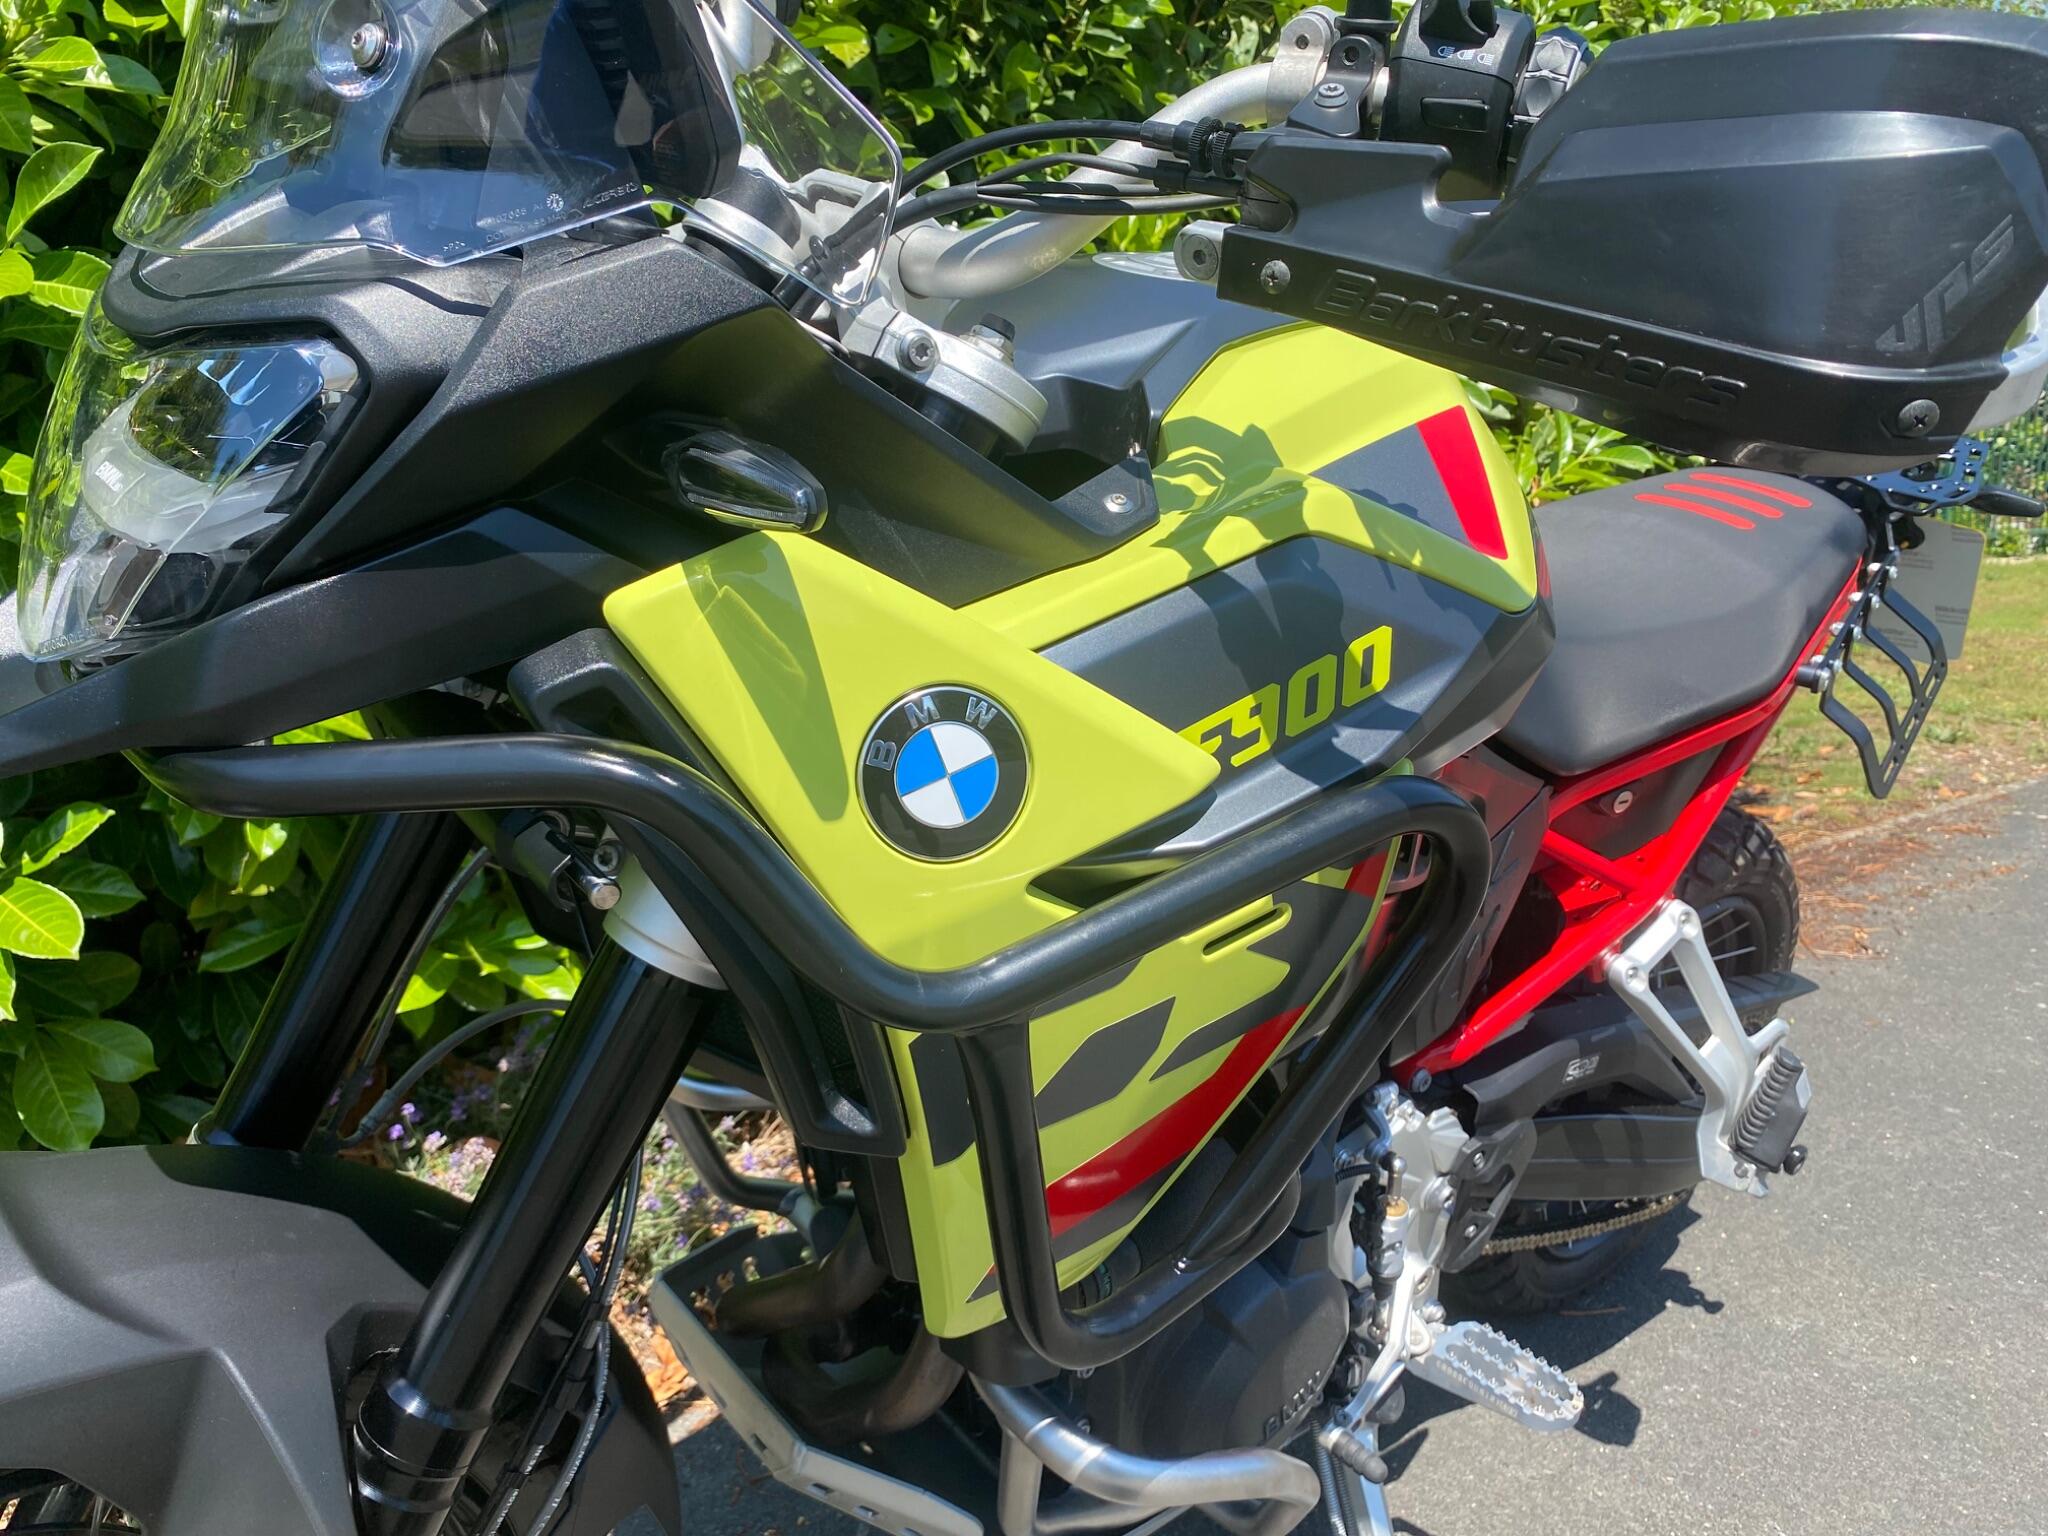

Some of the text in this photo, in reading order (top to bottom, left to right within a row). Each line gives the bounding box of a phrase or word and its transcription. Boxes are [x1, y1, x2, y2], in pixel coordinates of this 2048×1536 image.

[1313, 268, 1748, 408] Barkbusters
[865, 695, 998, 771] BMW
[1176, 625, 1393, 768] F900
